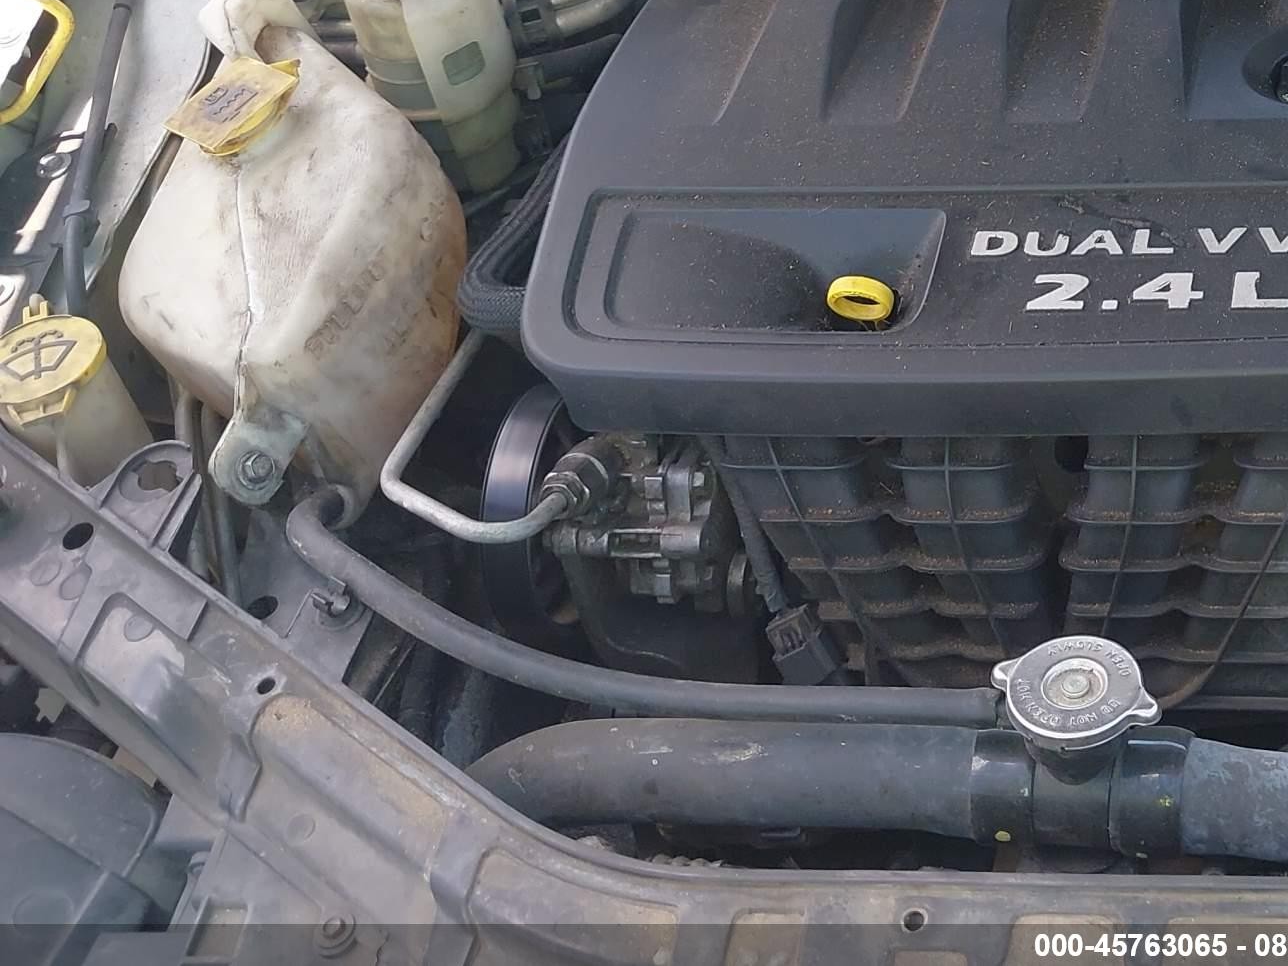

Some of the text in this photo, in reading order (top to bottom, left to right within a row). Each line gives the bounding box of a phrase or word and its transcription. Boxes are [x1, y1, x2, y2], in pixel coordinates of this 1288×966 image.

[971, 228, 1174, 256] DUAL
[1048, 640, 1132, 677] OPEN SLOWLY
[1016, 677, 1121, 727] DO NOT OPEN HOT
